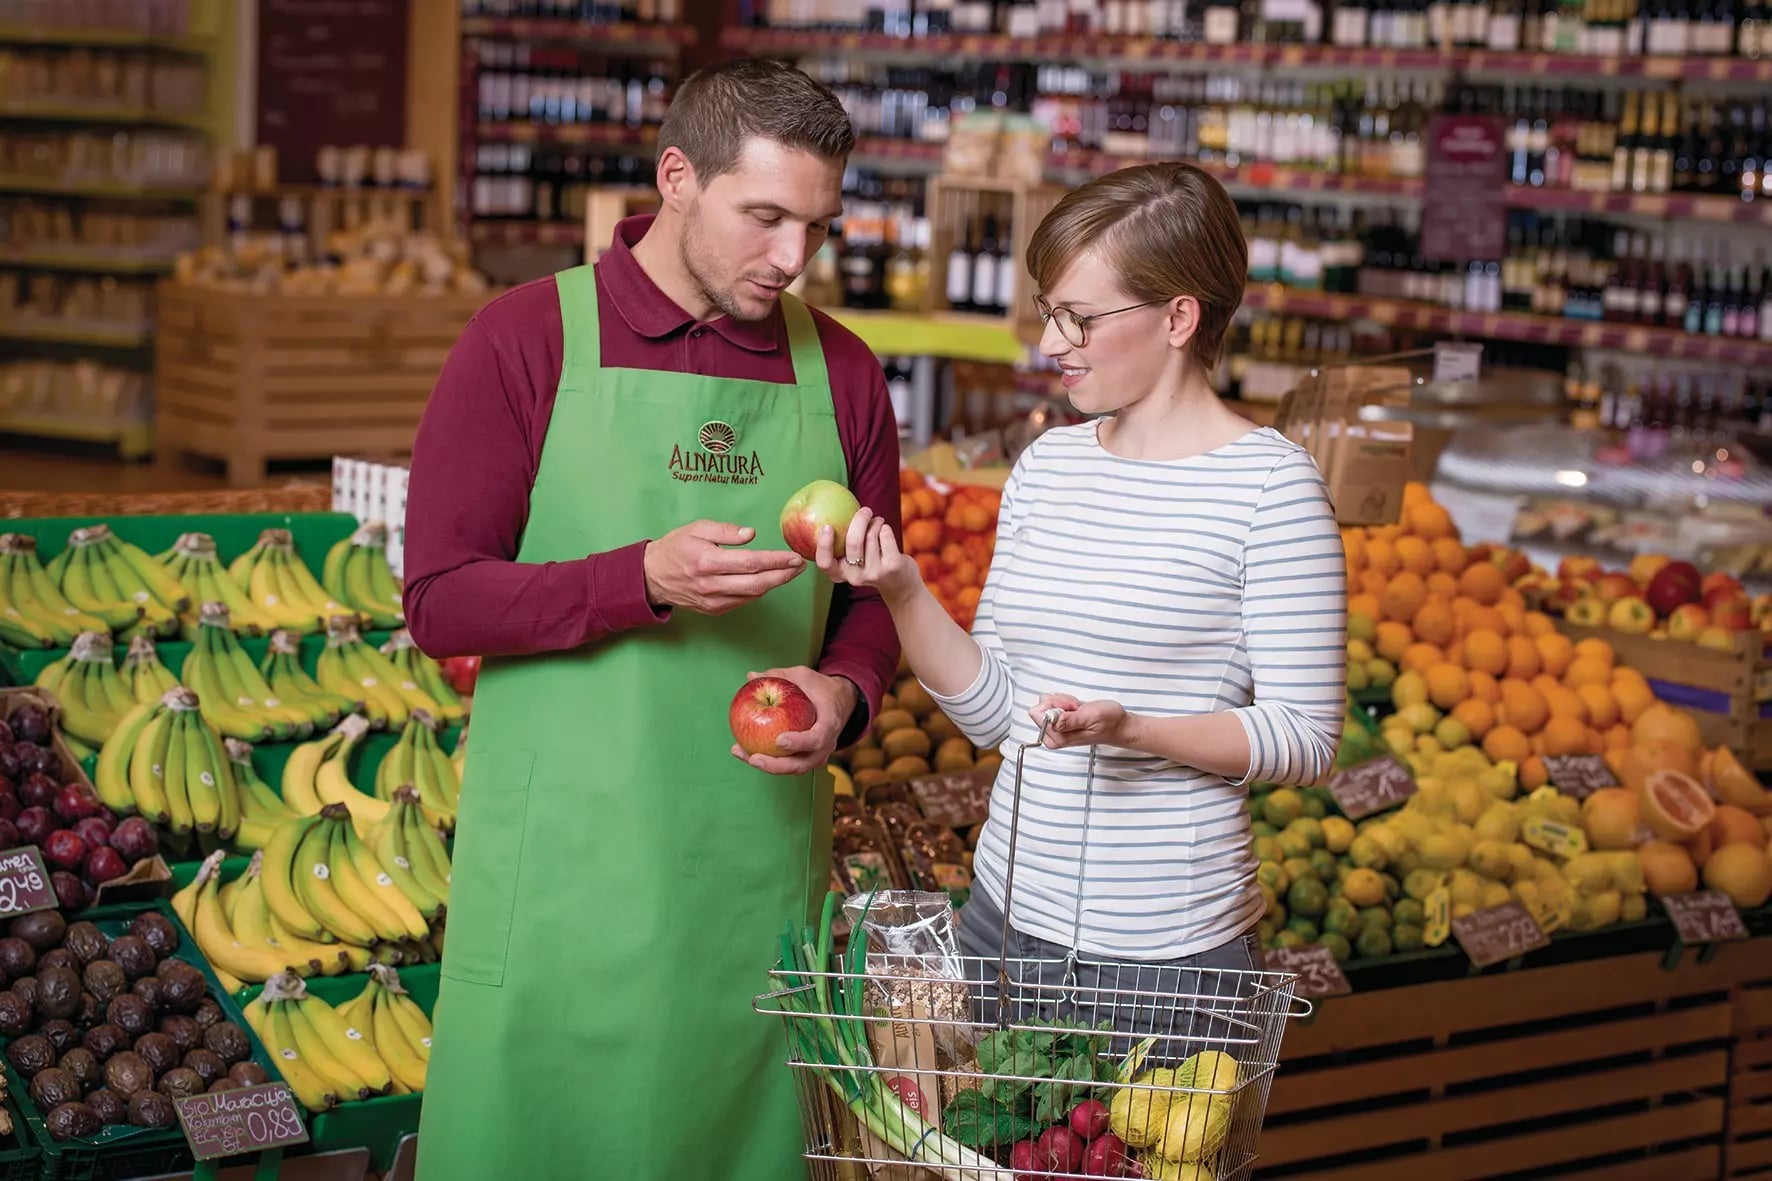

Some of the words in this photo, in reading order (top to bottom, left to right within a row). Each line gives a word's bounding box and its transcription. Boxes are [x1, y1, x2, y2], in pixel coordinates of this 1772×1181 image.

[668, 444, 764, 475] ALNATURA
[212, 1088, 290, 1113] Maracuja
[247, 1106, 302, 1143] 0,89
